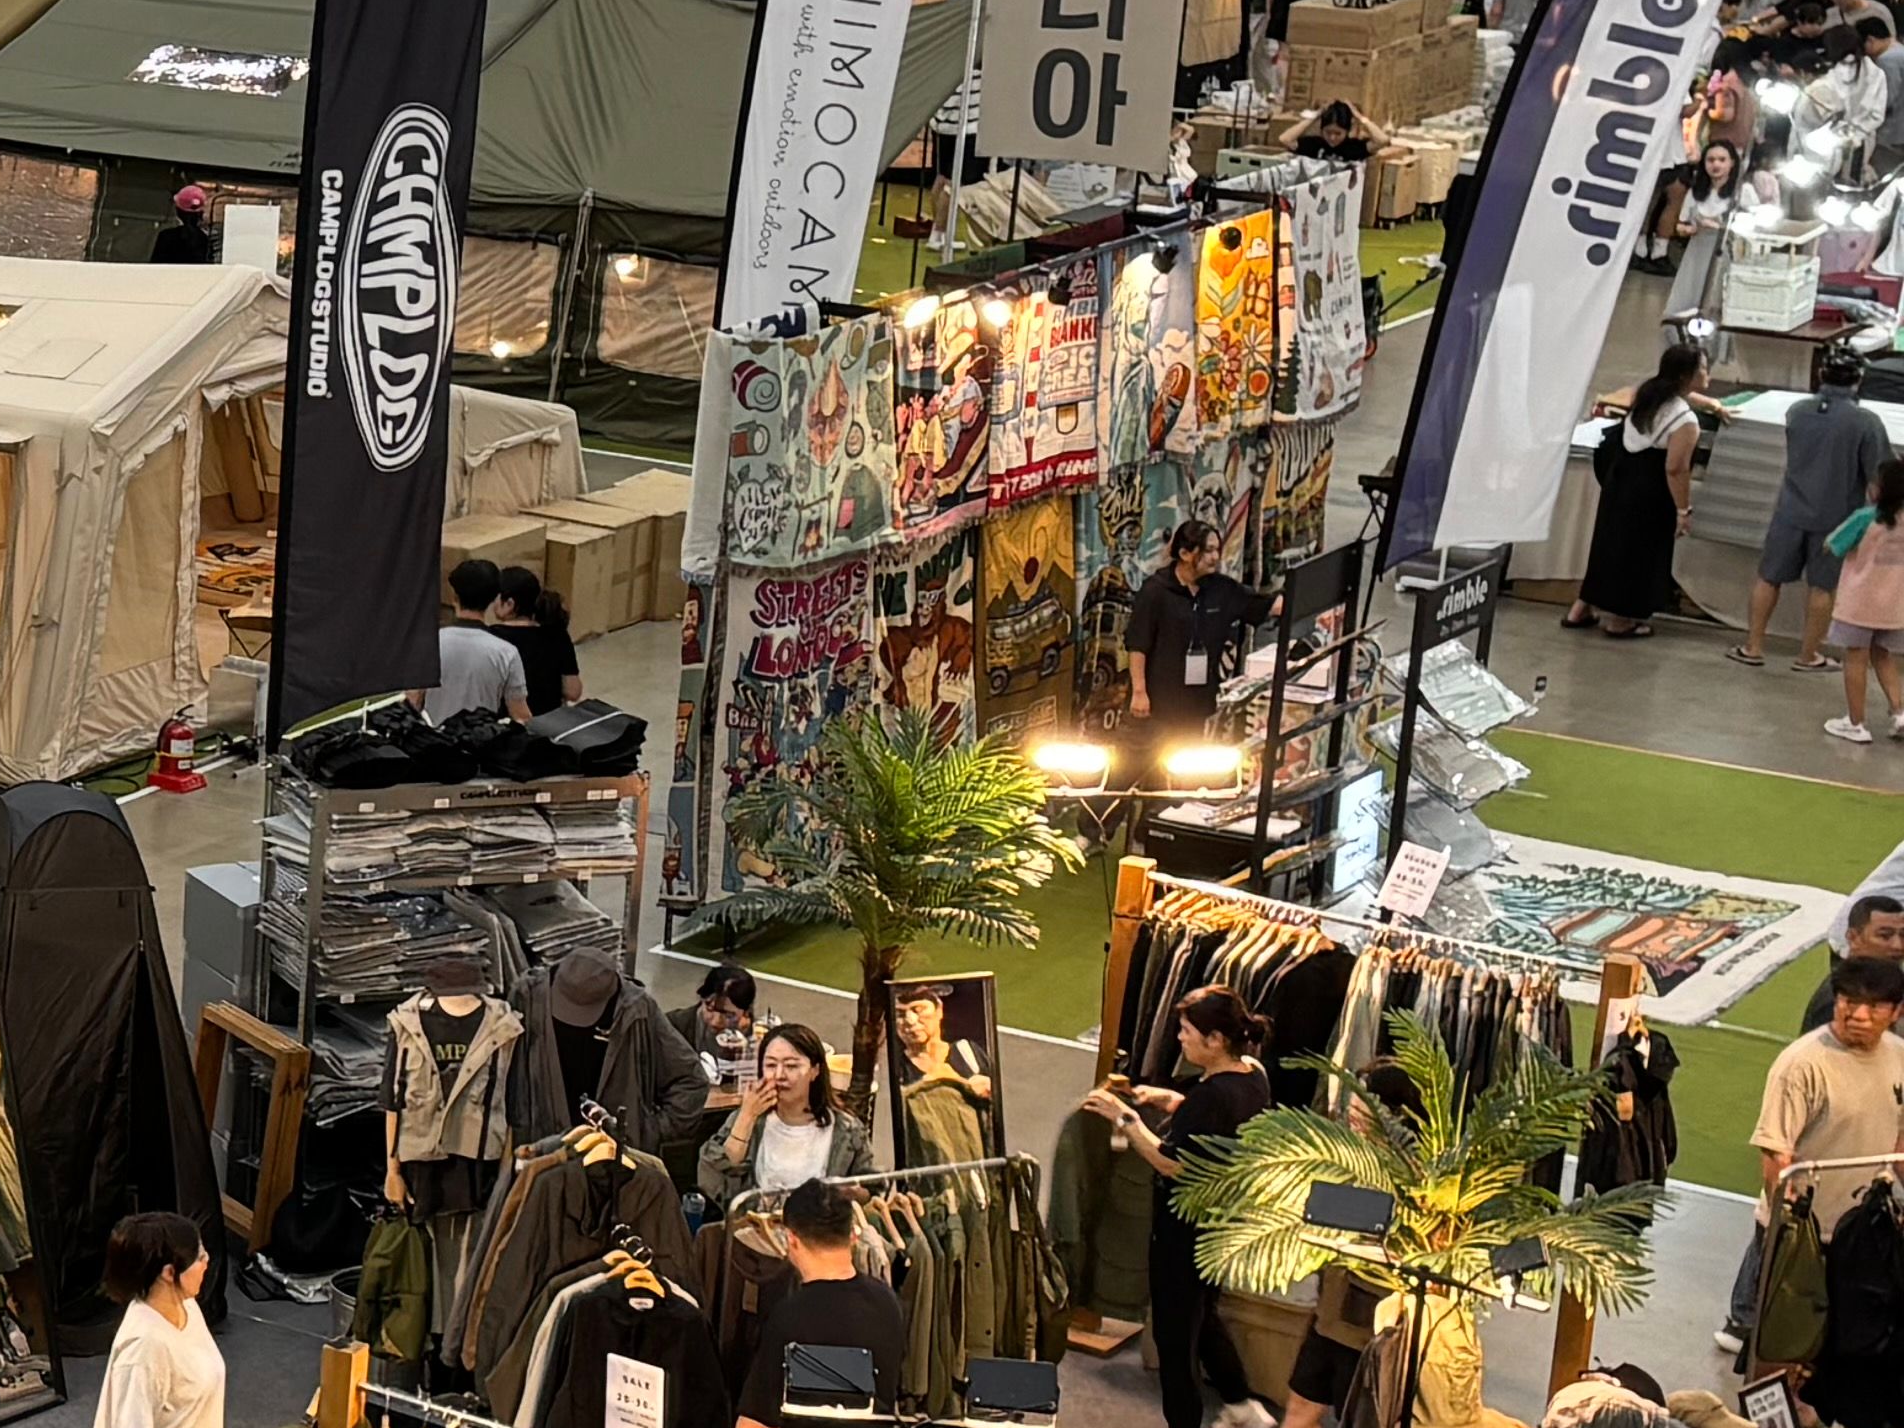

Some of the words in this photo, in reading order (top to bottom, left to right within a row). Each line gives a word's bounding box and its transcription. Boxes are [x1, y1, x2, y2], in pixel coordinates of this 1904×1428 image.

[793, 4, 813, 58] with
[767, 66, 802, 167] emotion
[753, 178, 782, 269] outdoors
[306, 169, 346, 401] CAMPLOGSTUDIO
